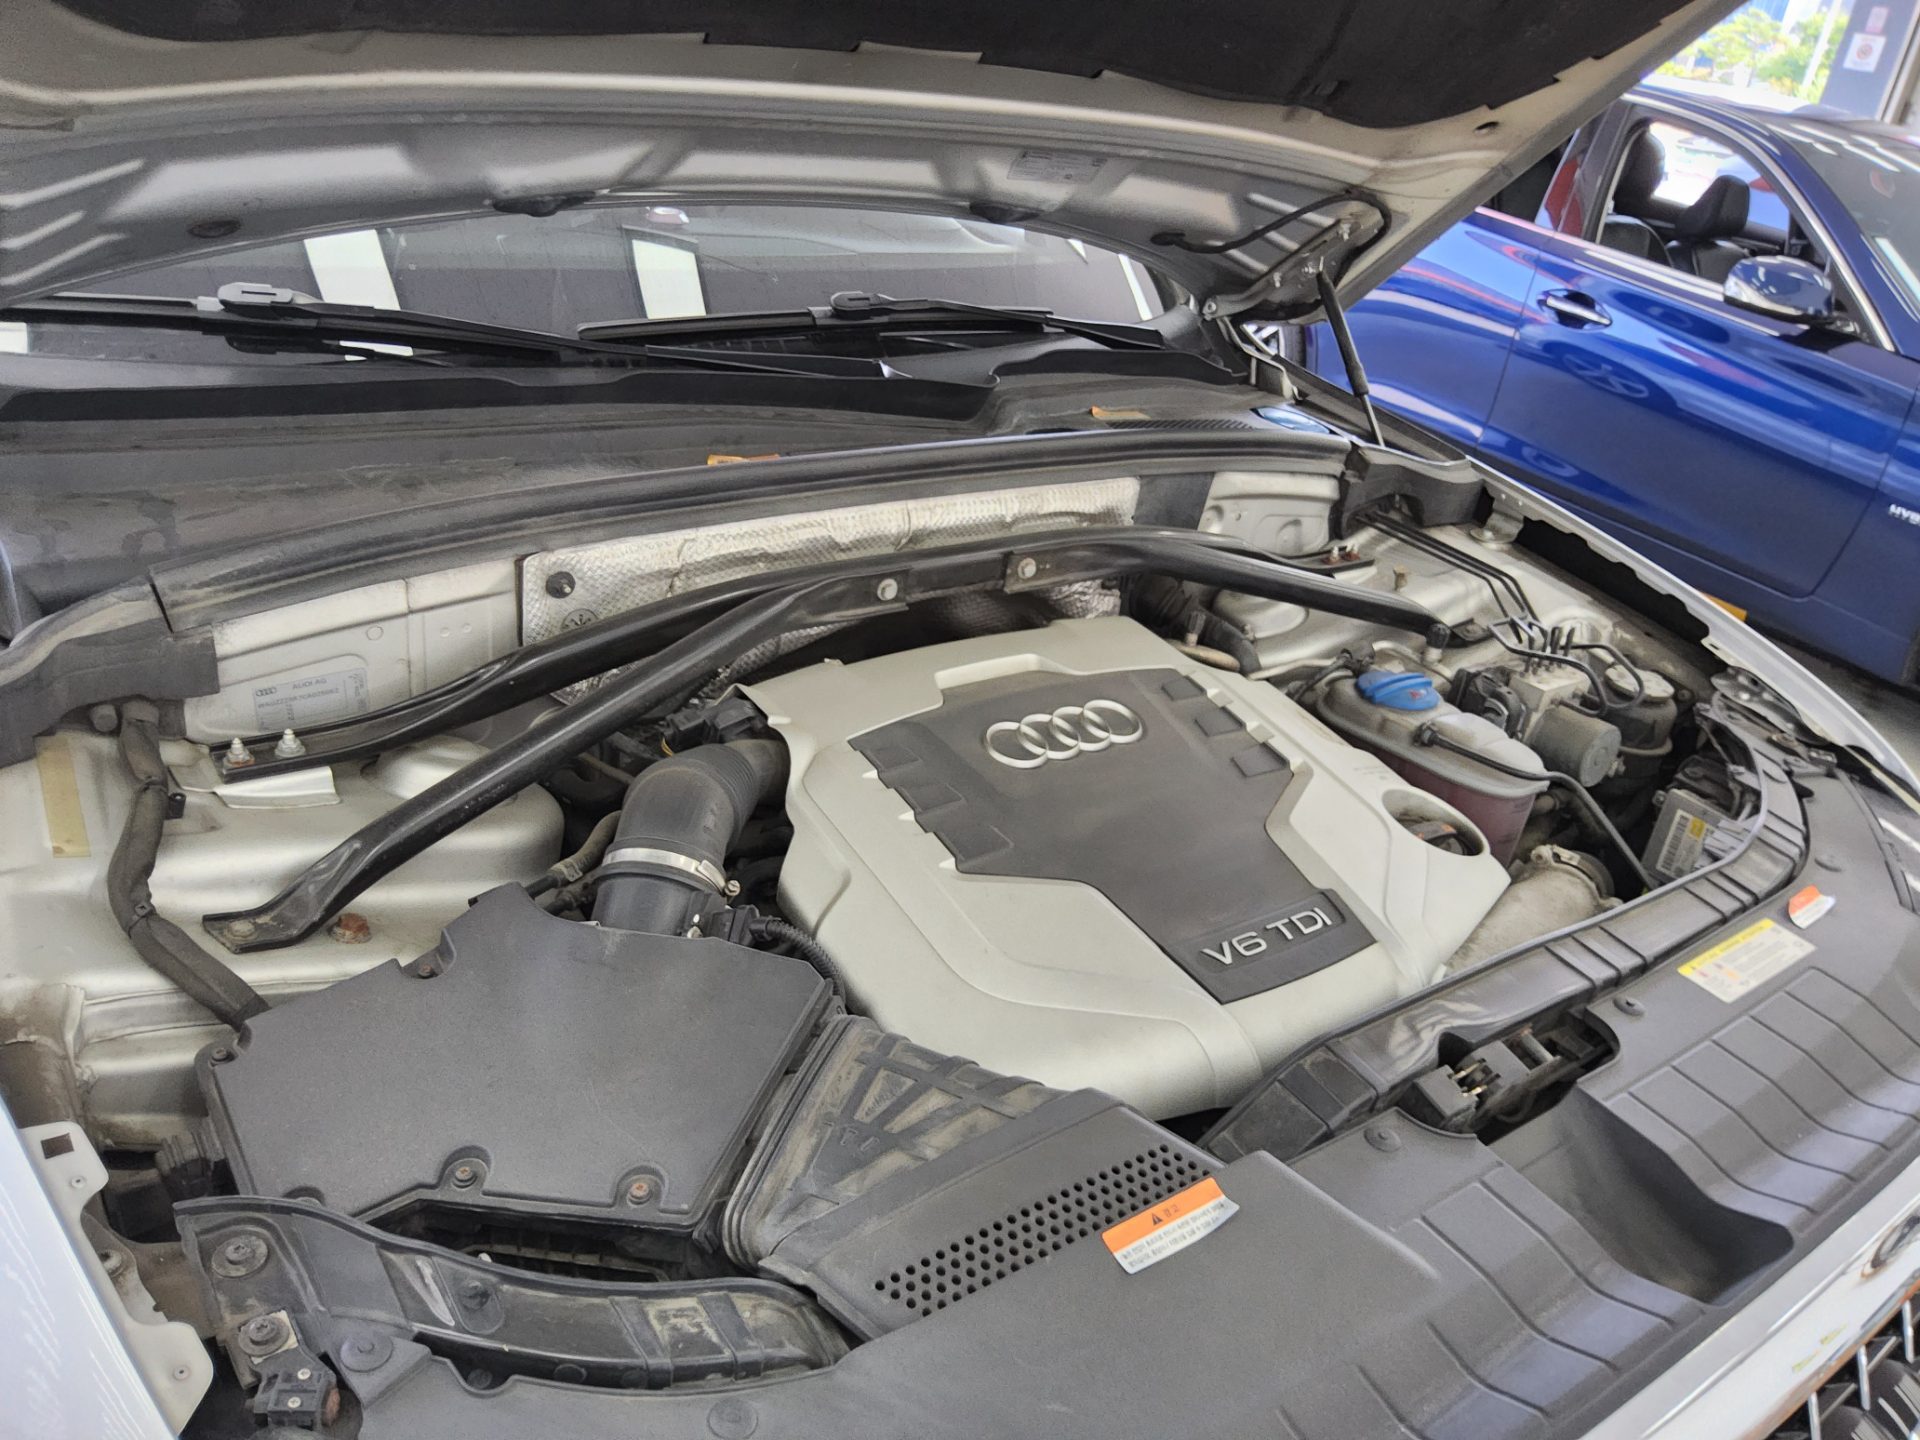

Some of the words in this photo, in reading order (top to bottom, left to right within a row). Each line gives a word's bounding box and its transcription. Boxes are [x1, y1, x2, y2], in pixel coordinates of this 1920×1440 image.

[292, 680, 313, 690] AUDI
[1200, 931, 1267, 965] V6
[1265, 907, 1332, 940] TDI
